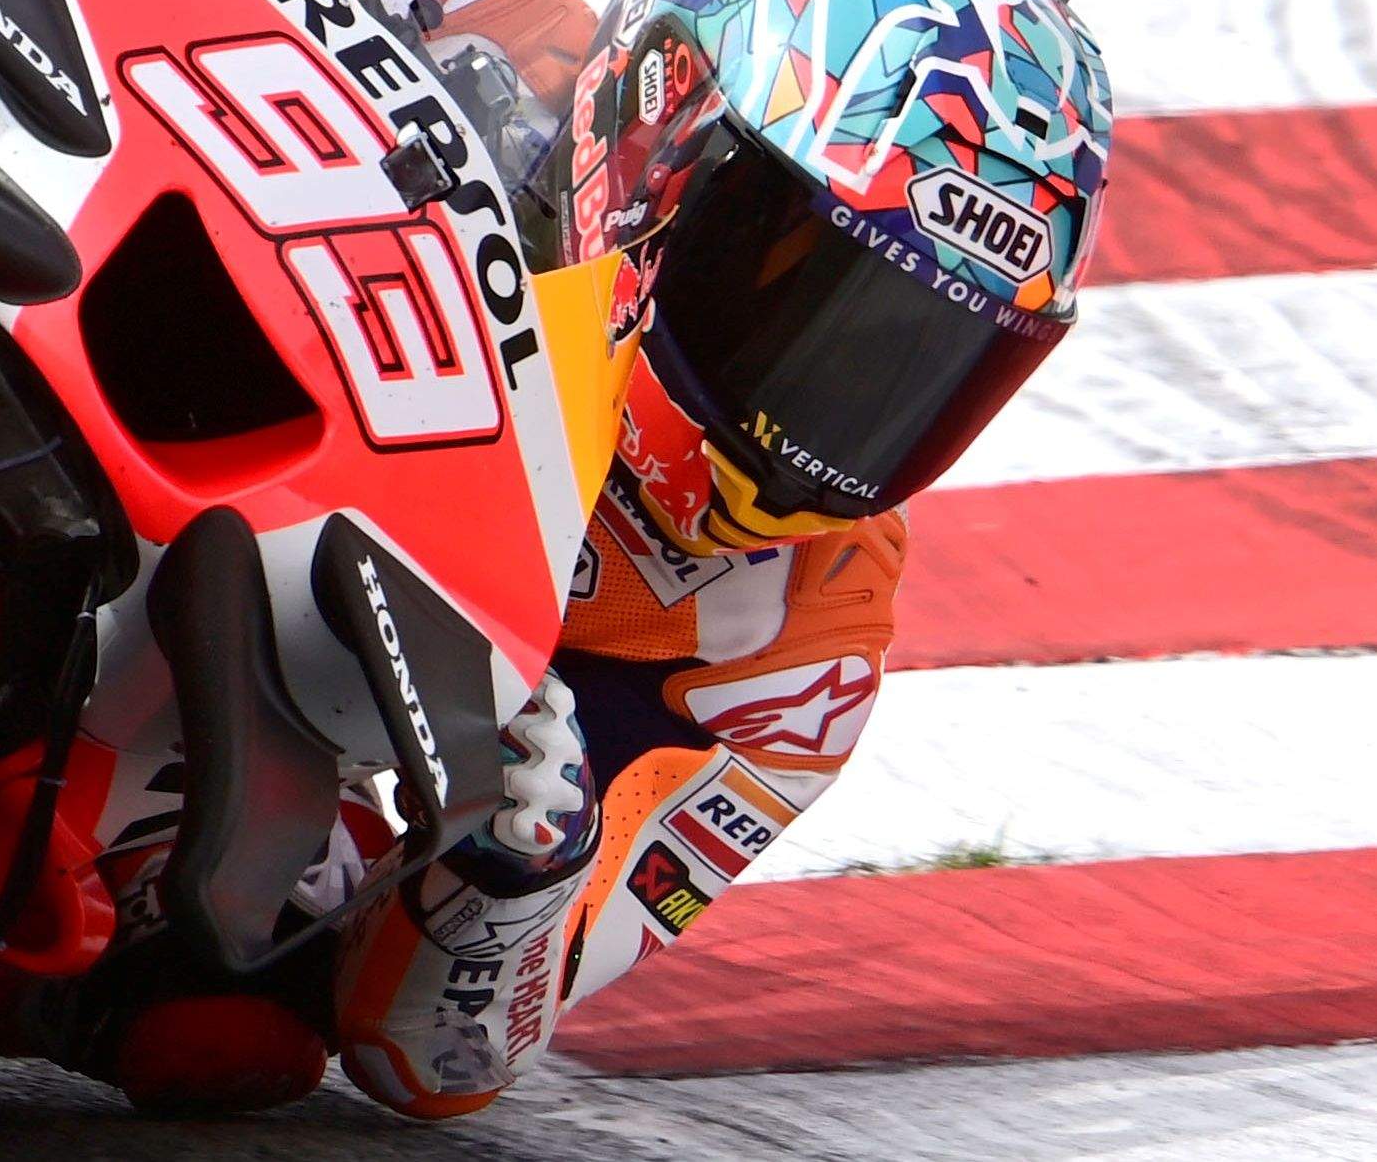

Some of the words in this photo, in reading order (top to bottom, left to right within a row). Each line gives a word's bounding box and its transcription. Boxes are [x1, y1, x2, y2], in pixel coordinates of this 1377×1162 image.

[118, 30, 505, 454] 93
[603, 200, 648, 233] Puig
[831, 205, 921, 273] GIVES
[931, 268, 988, 313] YOU
[928, 182, 1043, 272] SHOEI
[779, 437, 880, 499] VERTICAL
[356, 553, 450, 810] HONDA
